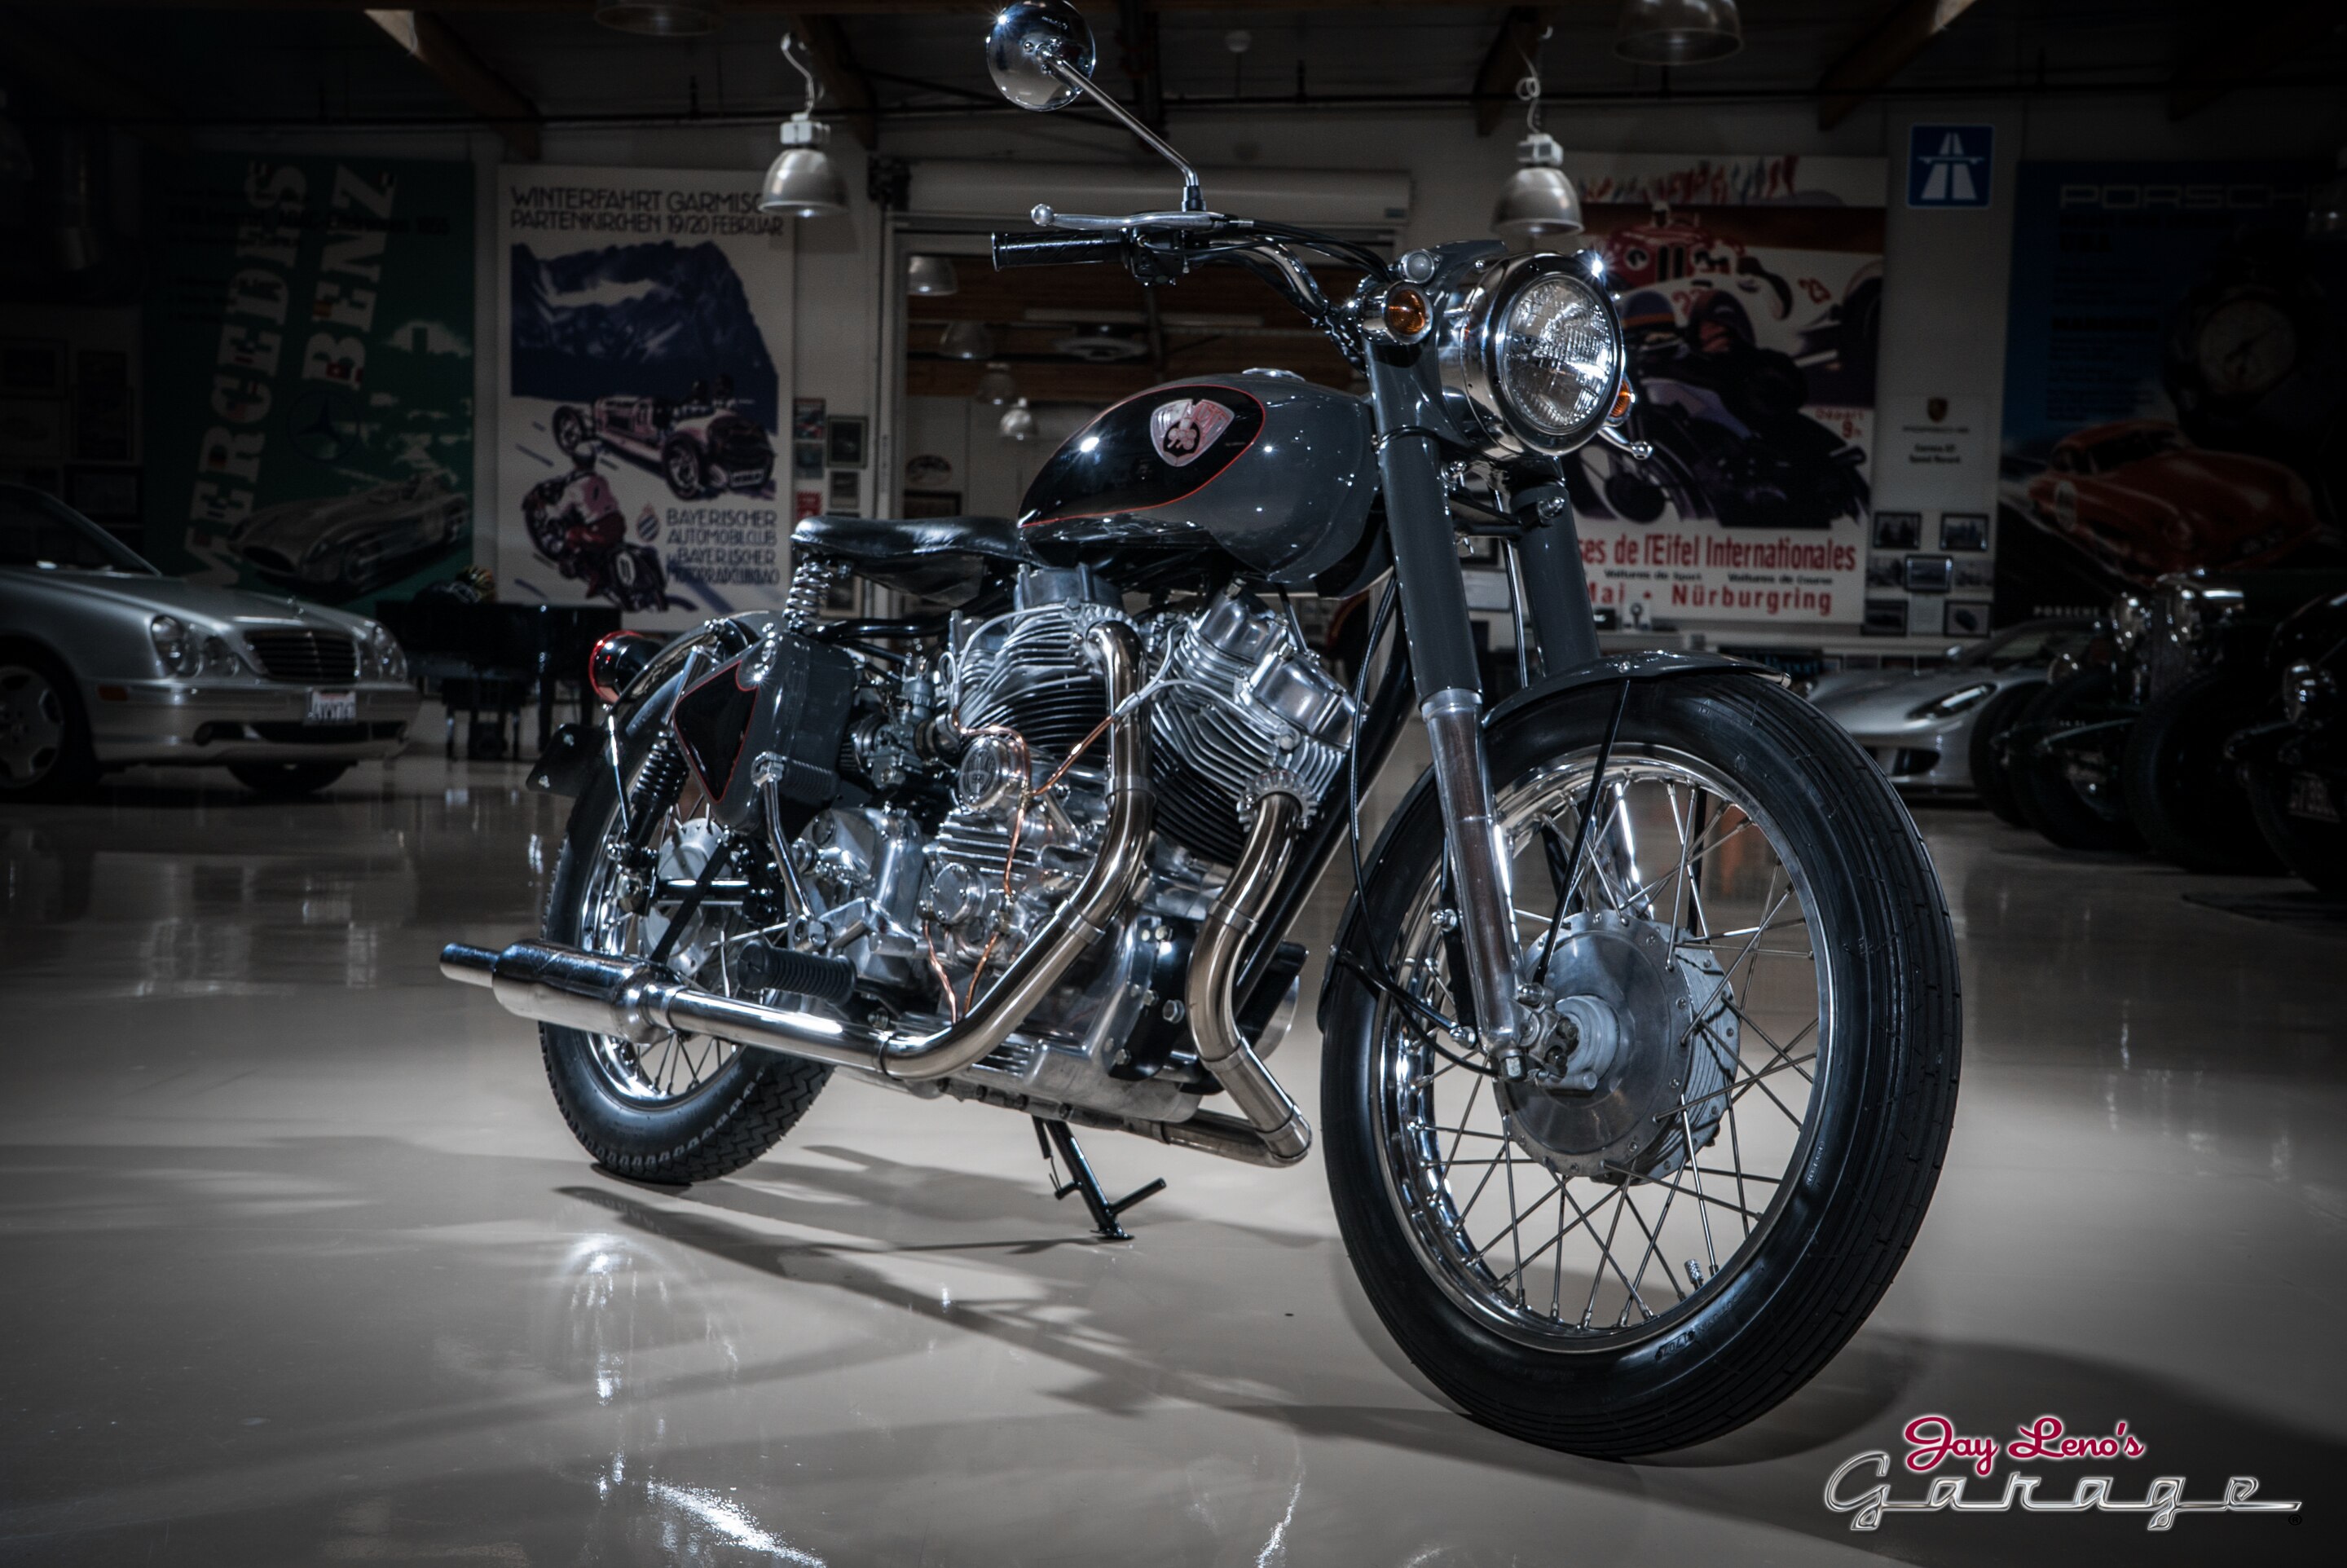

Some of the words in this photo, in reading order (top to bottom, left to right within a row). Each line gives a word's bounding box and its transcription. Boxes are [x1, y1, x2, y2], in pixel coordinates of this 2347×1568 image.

[511, 187, 662, 211] WINTERFAHRT
[666, 192, 764, 214] GARMISC
[2060, 184, 2309, 210] PORSCH
[511, 209, 661, 232] PARTENKIRCHEN
[711, 215, 784, 236] FEBRUAR
[302, 164, 398, 390] BENZ
[184, 161, 309, 586] MERCEDES
[667, 508, 777, 526] BAYERISCHER
[1614, 533, 1639, 565] de
[1706, 535, 1856, 571] Internationales
[1671, 582, 1832, 617] Nürburgring
